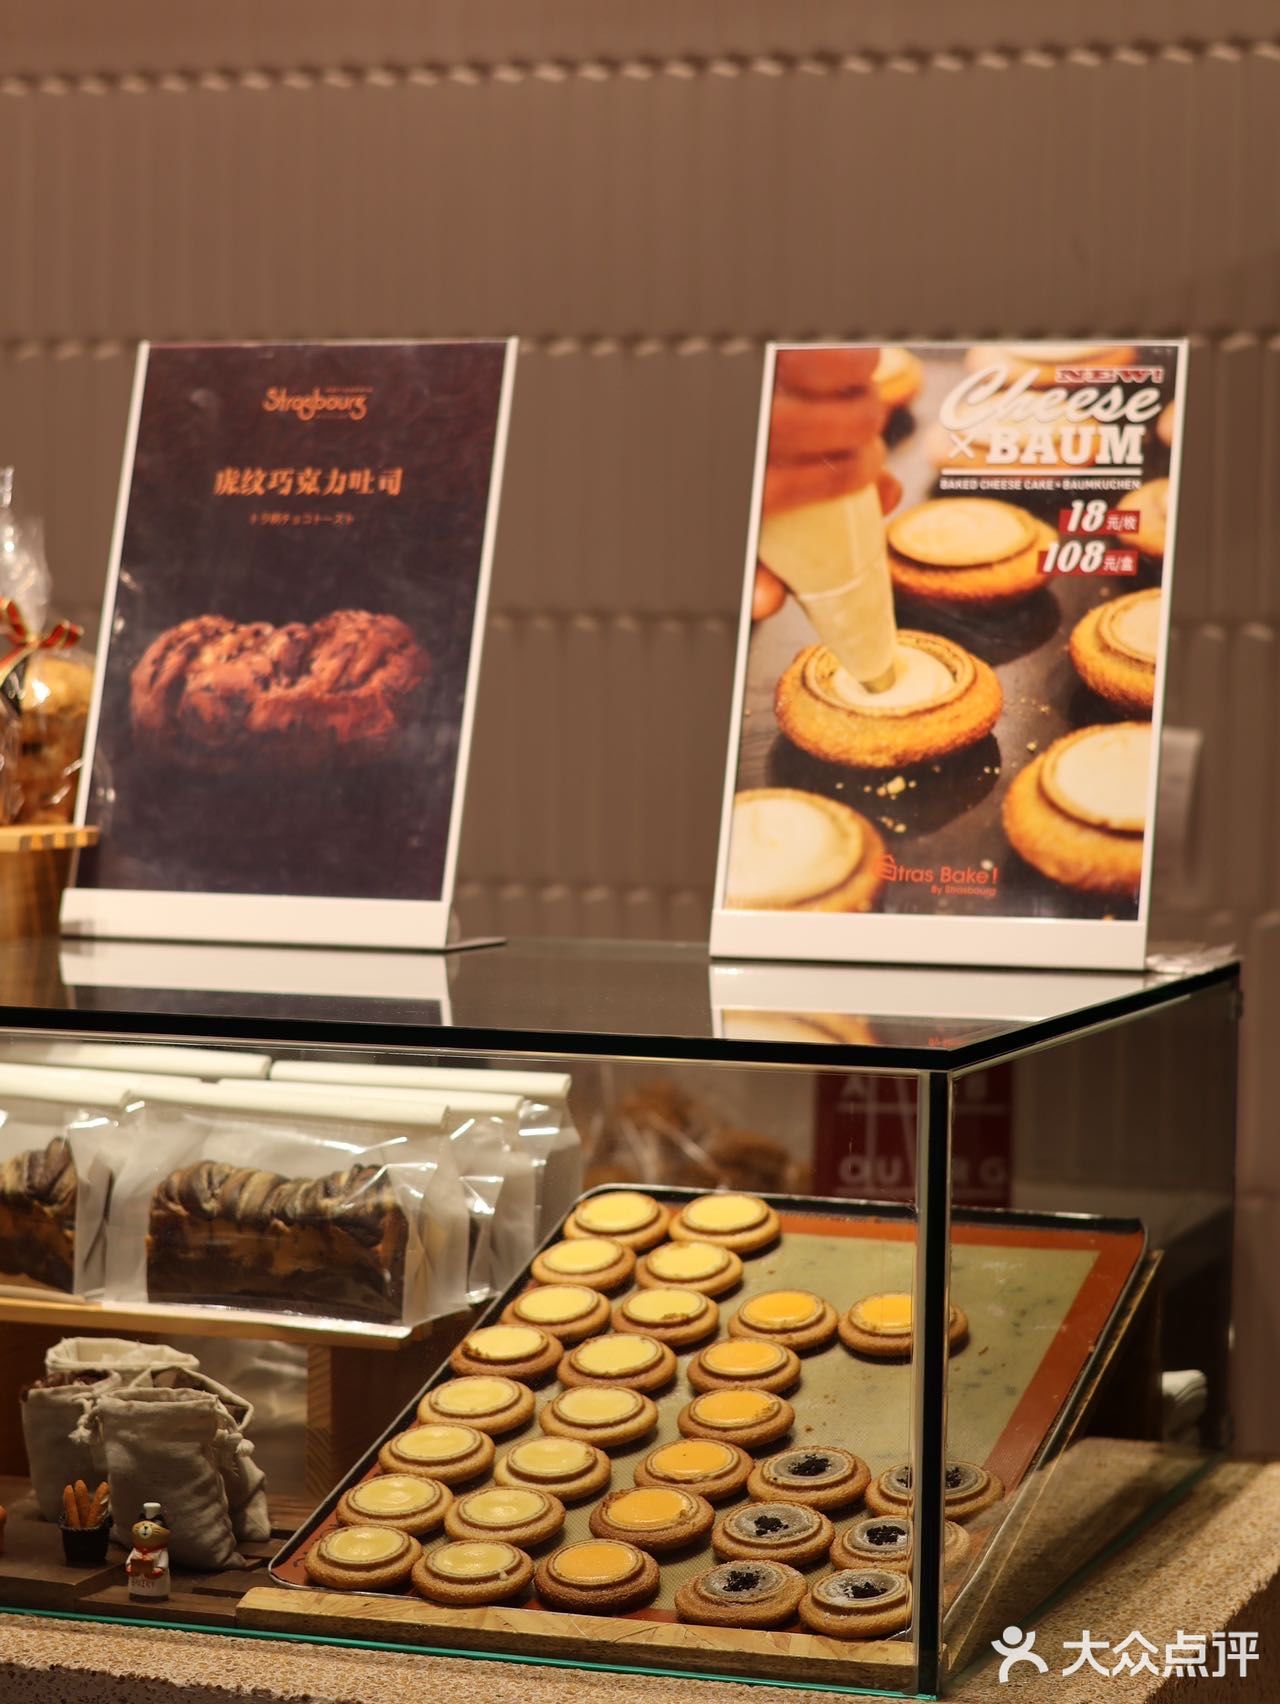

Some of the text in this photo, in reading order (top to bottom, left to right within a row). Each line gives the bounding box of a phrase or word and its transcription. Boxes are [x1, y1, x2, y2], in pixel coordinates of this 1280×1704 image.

[1055, 366, 1164, 384] NEW!
[940, 366, 1162, 431] Cheese
[986, 424, 1146, 465] BAUM
[214, 467, 404, 496] 虎纹巧克力吐司
[939, 478, 979, 491] BAKED
[979, 478, 1022, 491] CHEESE
[1023, 478, 1055, 491] CAKE
